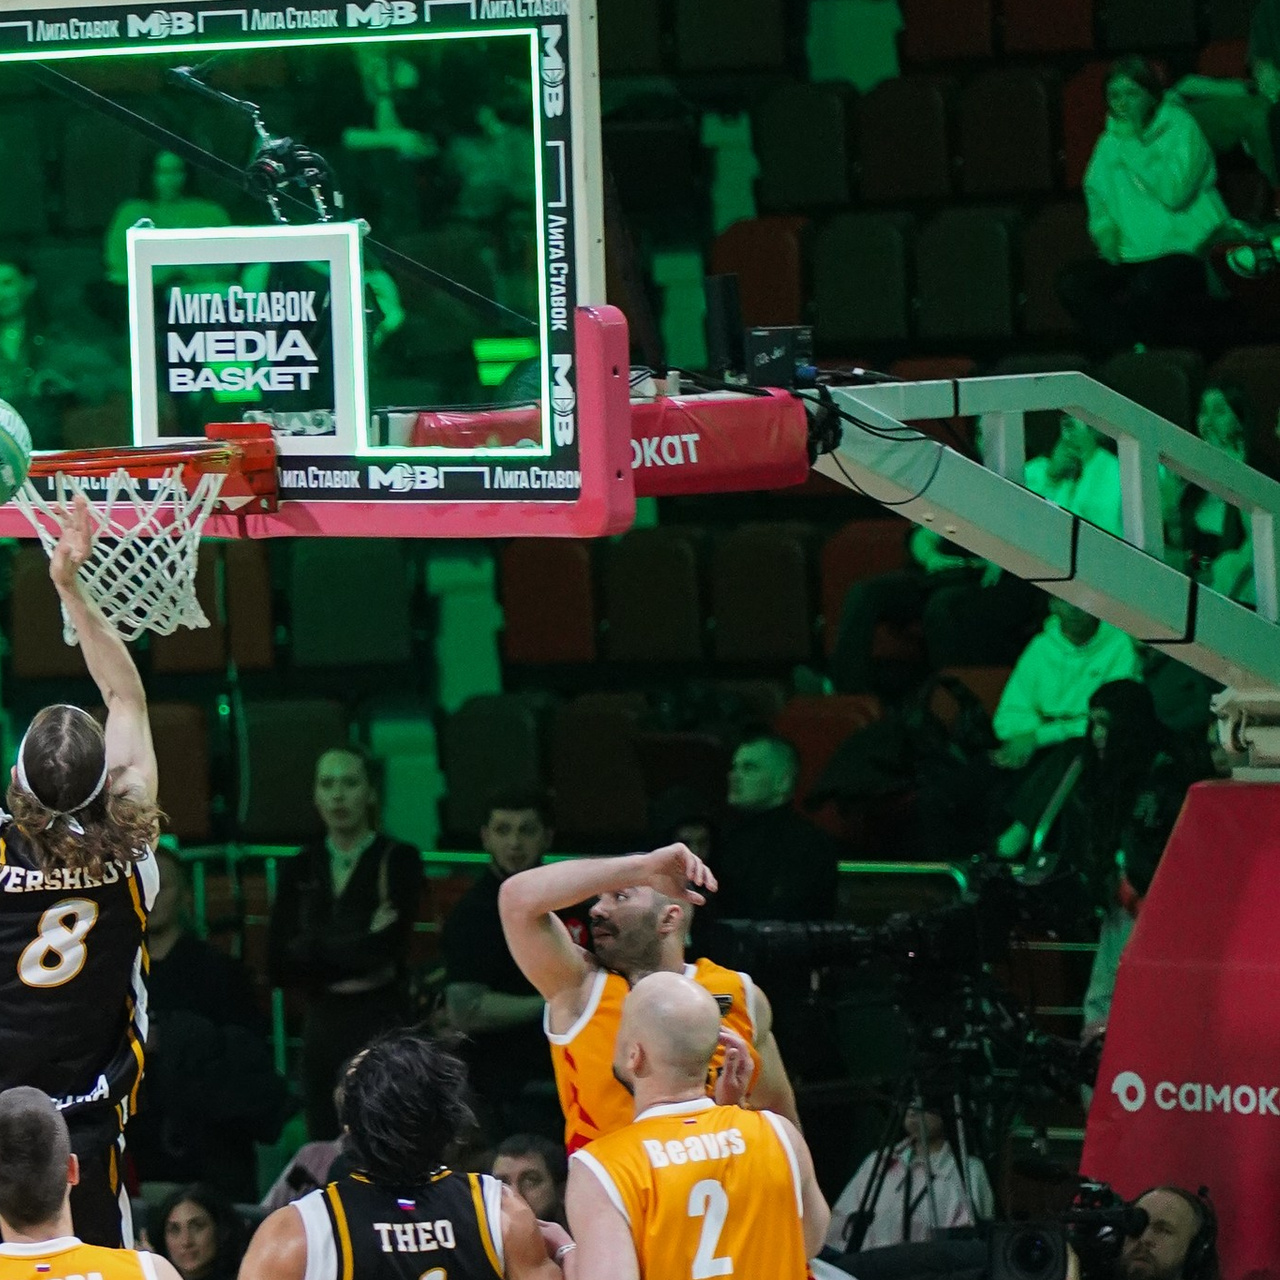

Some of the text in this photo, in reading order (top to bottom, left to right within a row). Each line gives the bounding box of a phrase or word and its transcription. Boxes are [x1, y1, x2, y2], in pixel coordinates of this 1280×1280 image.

[167, 329, 318, 363] MEDIA
[169, 366, 320, 392] BASKET
[16, 897, 99, 988] 8
[373, 1219, 456, 1253] THEO
[688, 1179, 734, 1280] 2
